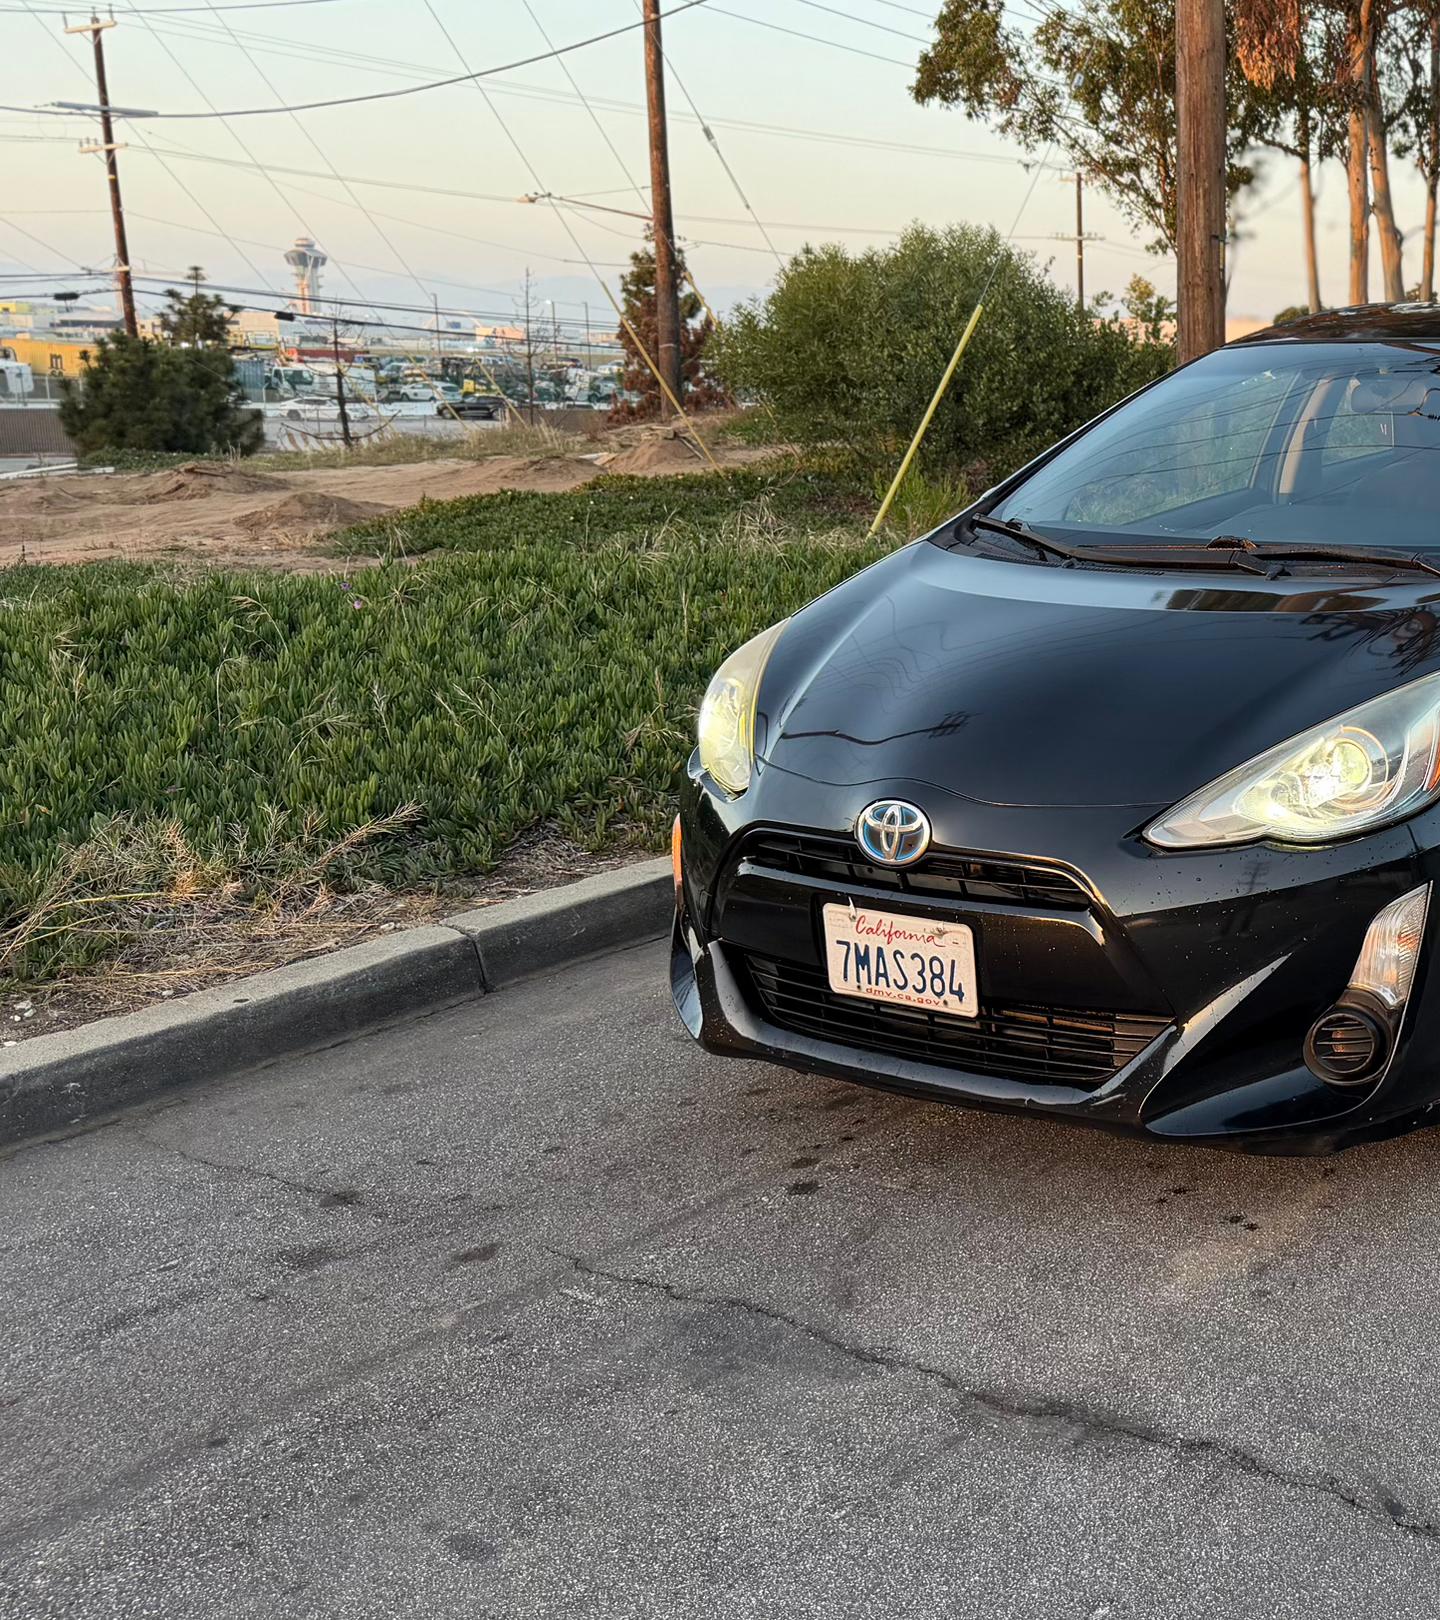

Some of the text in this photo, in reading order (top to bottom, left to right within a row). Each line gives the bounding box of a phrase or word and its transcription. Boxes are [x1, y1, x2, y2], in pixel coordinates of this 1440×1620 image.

[855, 914, 946, 947] California
[836, 939, 965, 1003] 7MAS384
[865, 987, 940, 1006] dmv.ca.gov
